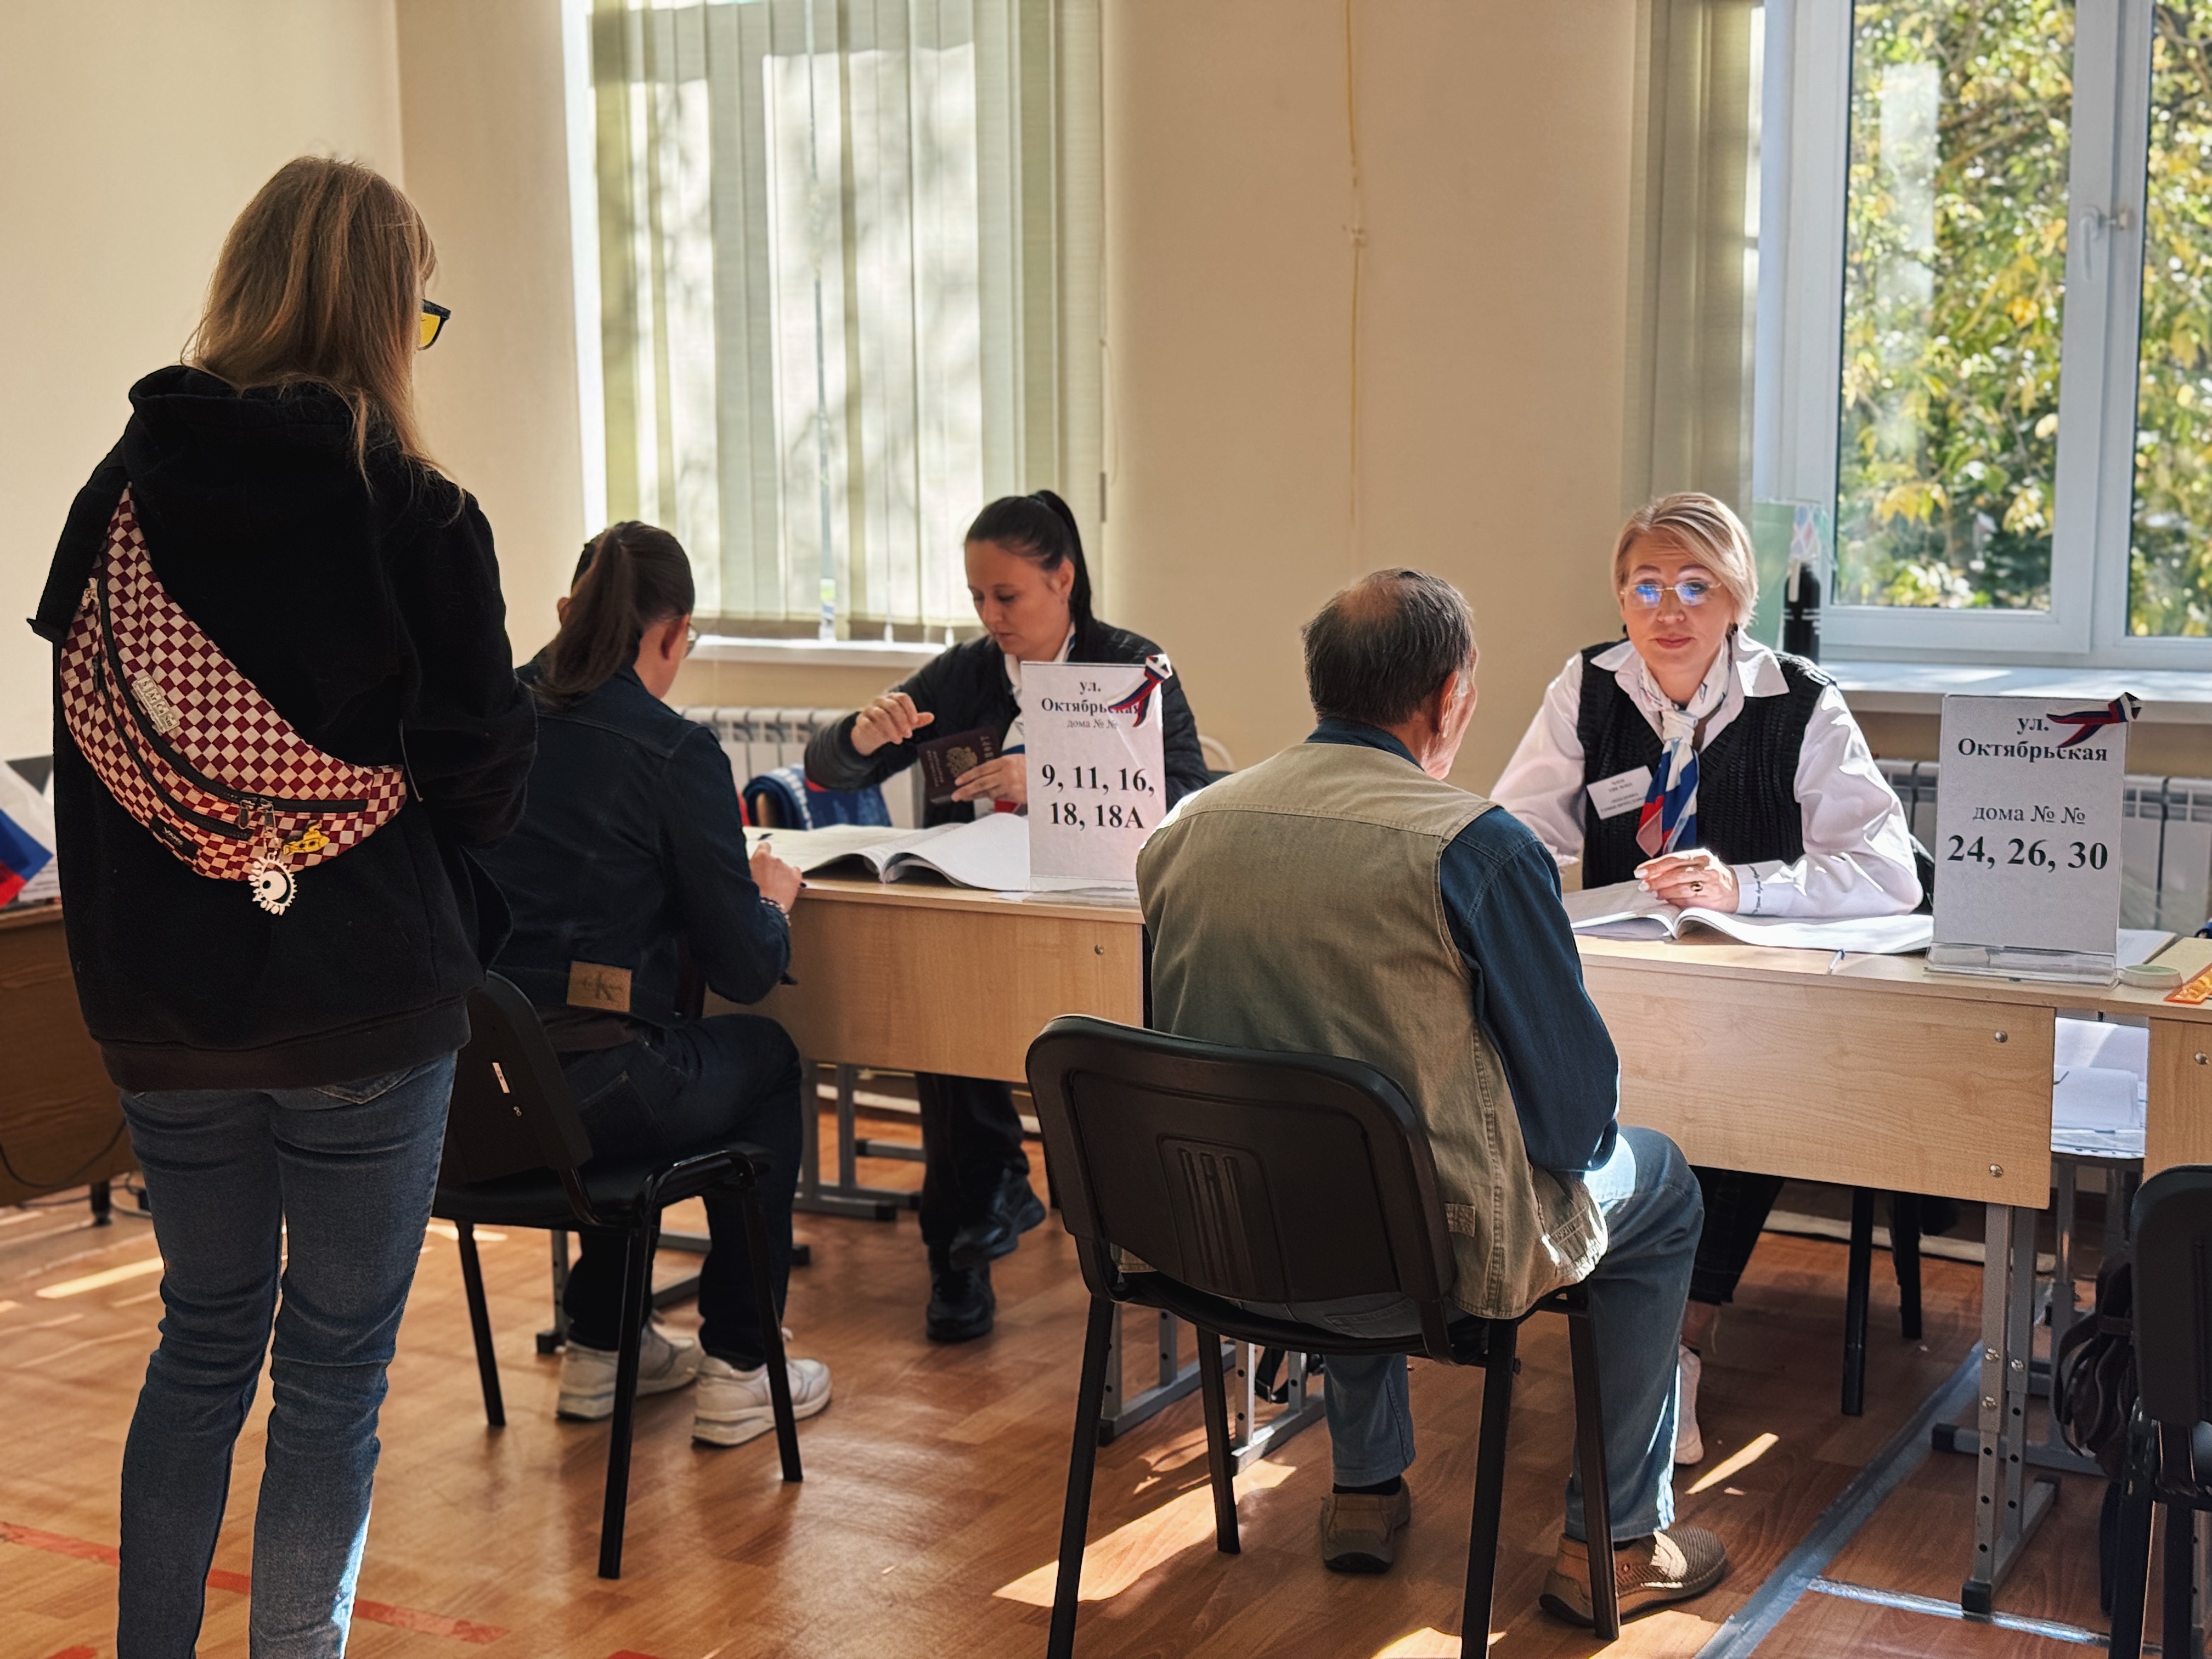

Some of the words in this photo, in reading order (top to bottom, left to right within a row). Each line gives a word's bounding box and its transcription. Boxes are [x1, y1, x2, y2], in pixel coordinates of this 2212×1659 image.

[1080, 681, 1101, 695] ул.
[1067, 720, 1091, 729] дома
[2017, 718, 2050, 735] ул.
[1958, 738, 2108, 763] Октябрьская
[1042, 764, 1064, 793] 9,
[1073, 766, 1109, 795] 11,
[1118, 768, 1155, 798] 16,
[1049, 802, 1085, 831] 18,
[1095, 804, 1145, 829] 18А
[1972, 807, 2024, 821] дома
[2030, 805, 2055, 823] №
[2061, 807, 2086, 825] №
[1947, 835, 1995, 870] 24,
[2007, 838, 2056, 873] 26,
[2068, 842, 2108, 870] 30
